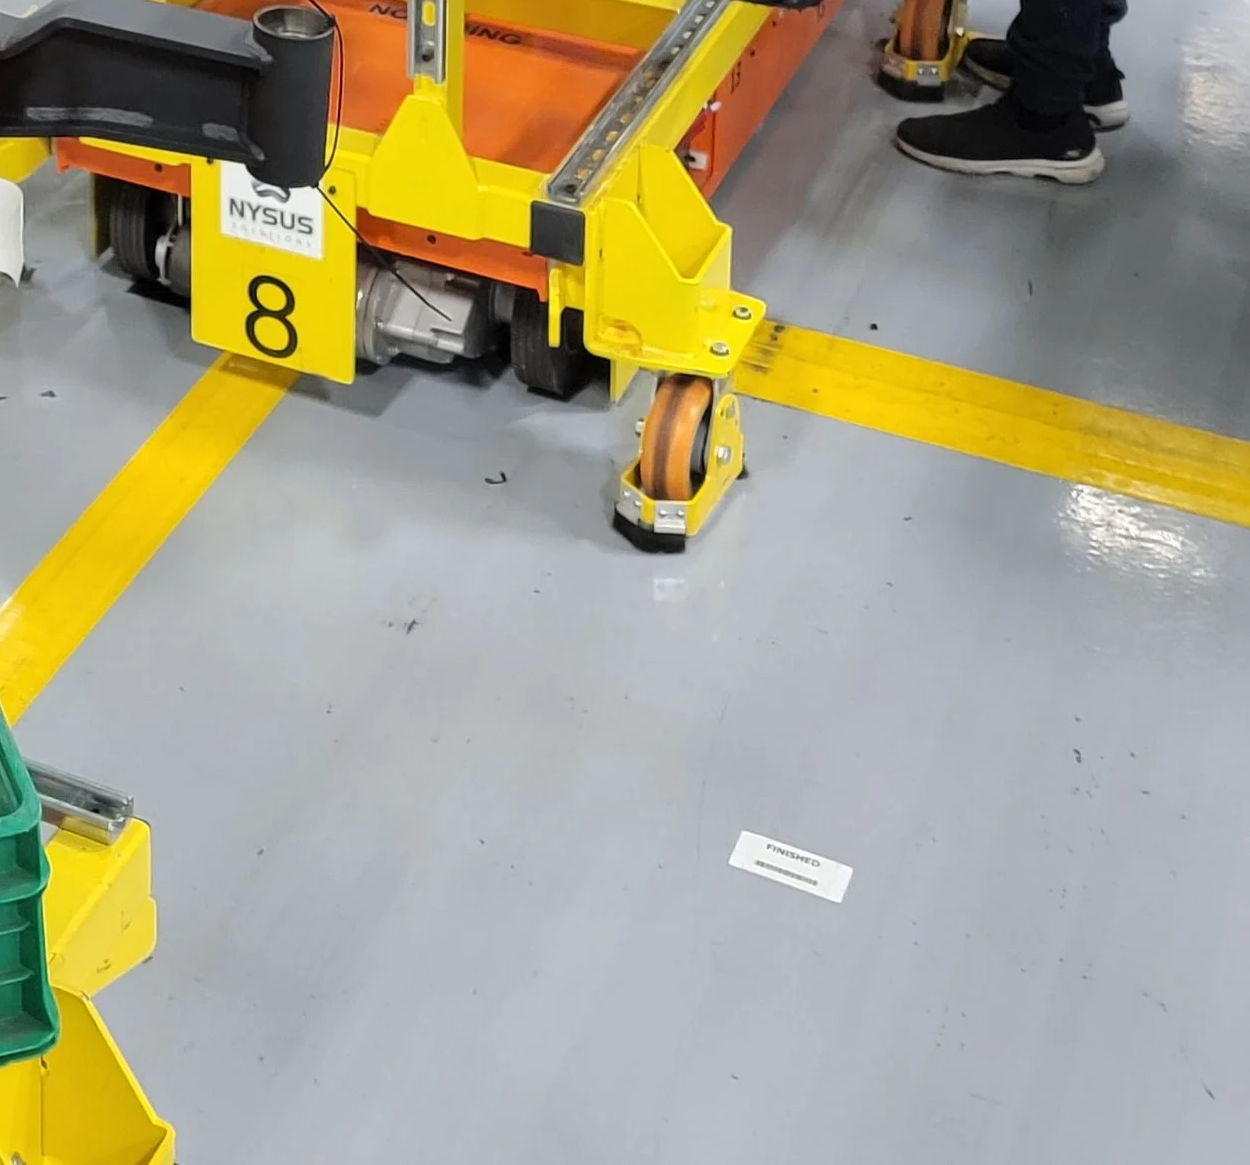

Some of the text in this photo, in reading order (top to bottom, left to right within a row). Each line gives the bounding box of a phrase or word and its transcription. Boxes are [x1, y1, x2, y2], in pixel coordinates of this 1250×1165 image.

[228, 198, 314, 236] NYSUS
[244, 274, 299, 359] 8
[766, 843, 822, 868] FINISHED
